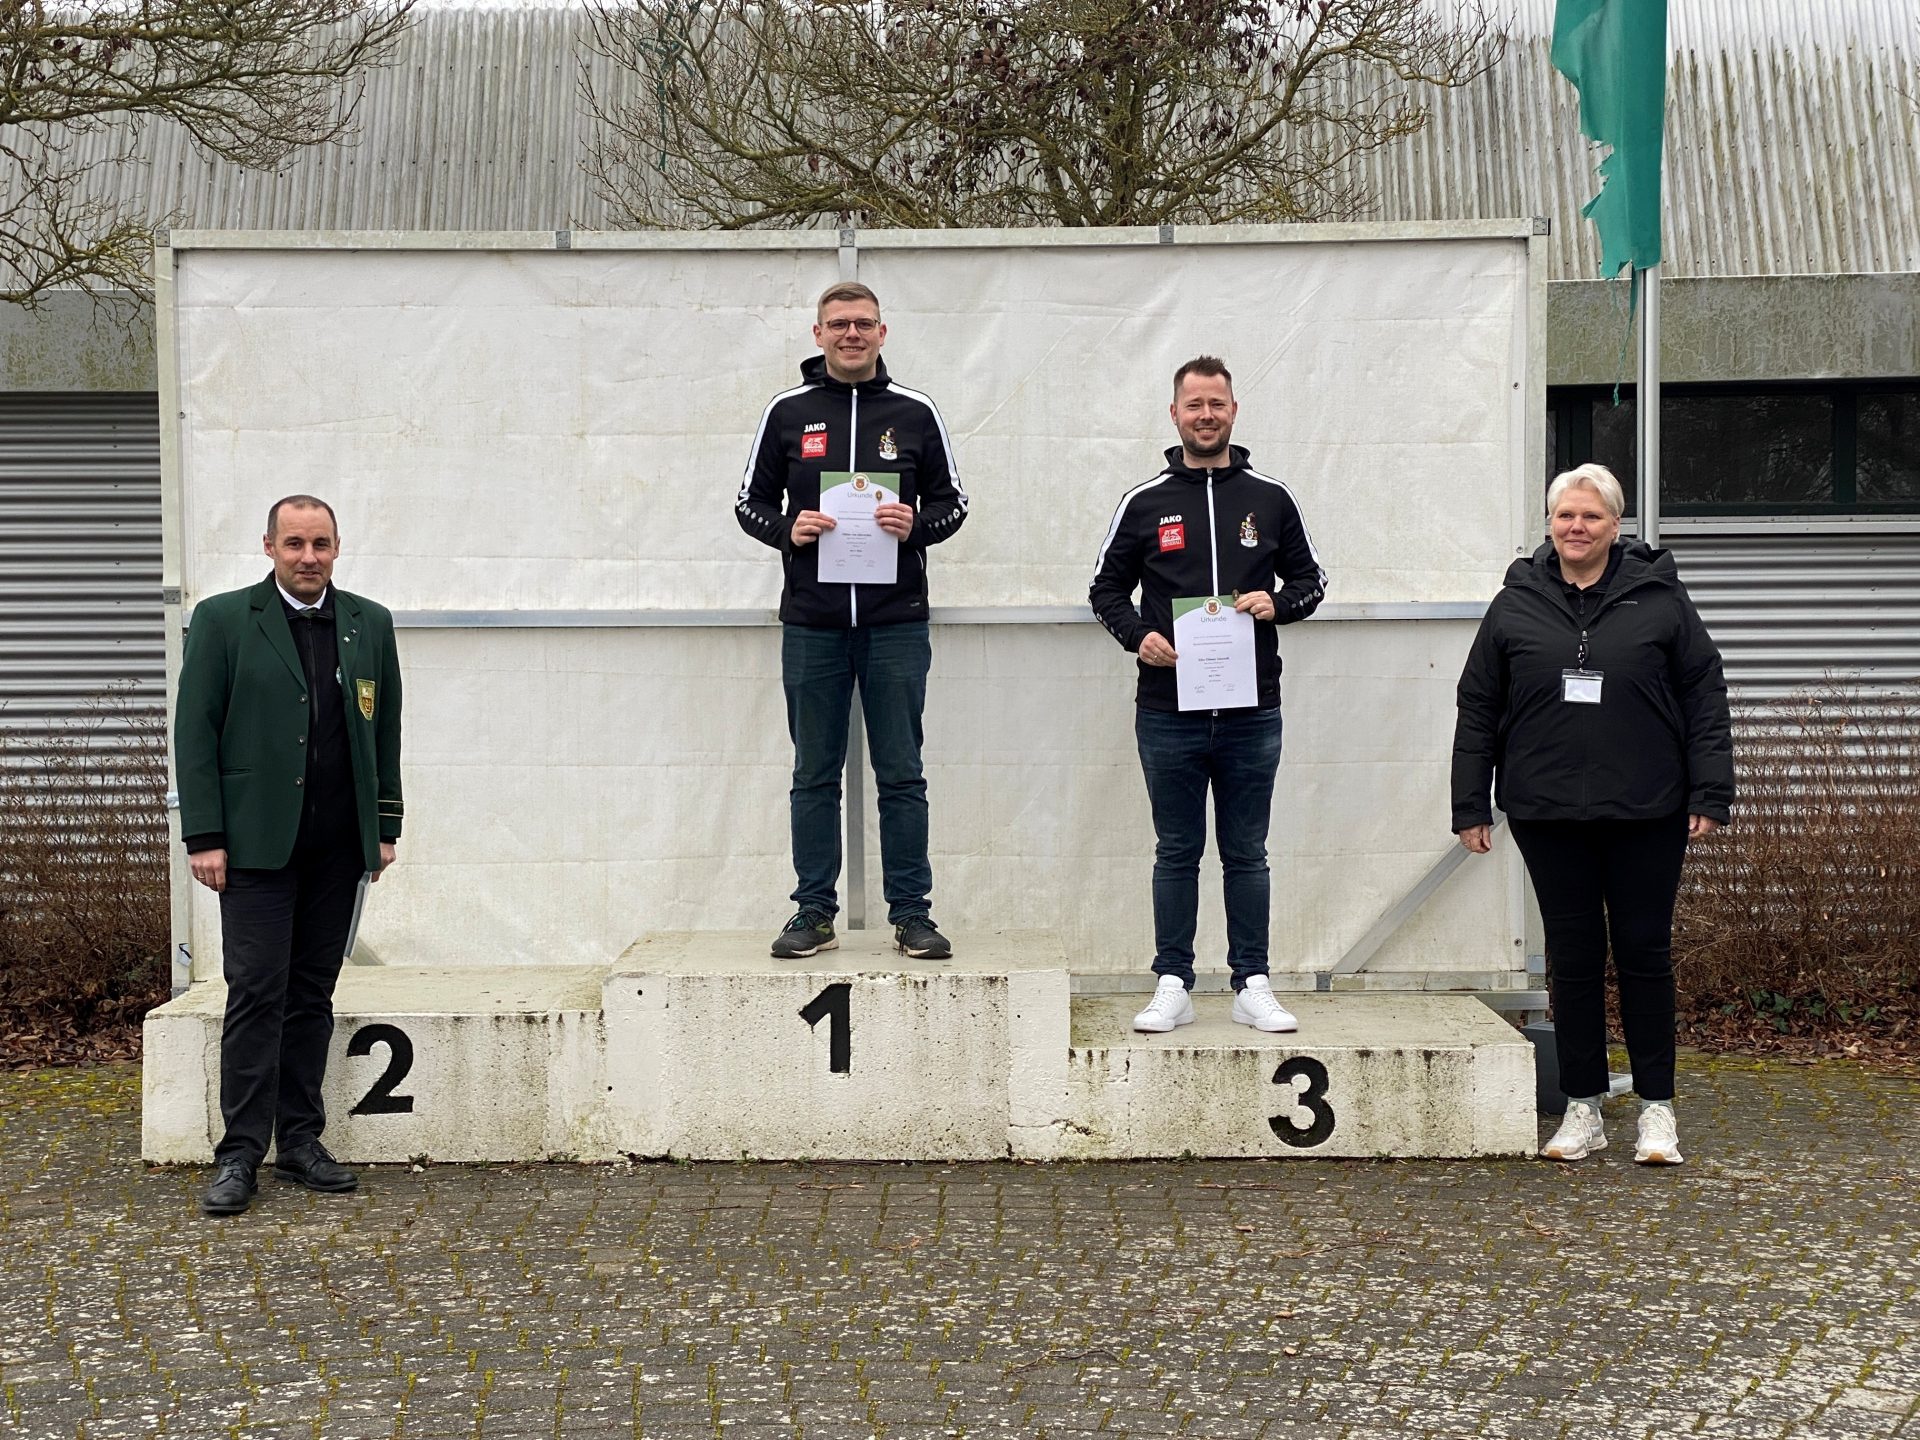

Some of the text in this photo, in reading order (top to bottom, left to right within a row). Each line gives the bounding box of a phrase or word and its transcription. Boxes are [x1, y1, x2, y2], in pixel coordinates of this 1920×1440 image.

[804, 422, 826, 433] JAKO
[847, 491, 873, 499] Urkunde
[1160, 514, 1182, 525] JAKO
[1200, 615, 1227, 623] Urkunde
[799, 983, 852, 1074] 1
[347, 1023, 414, 1115] 2
[1268, 1056, 1335, 1148] 3
